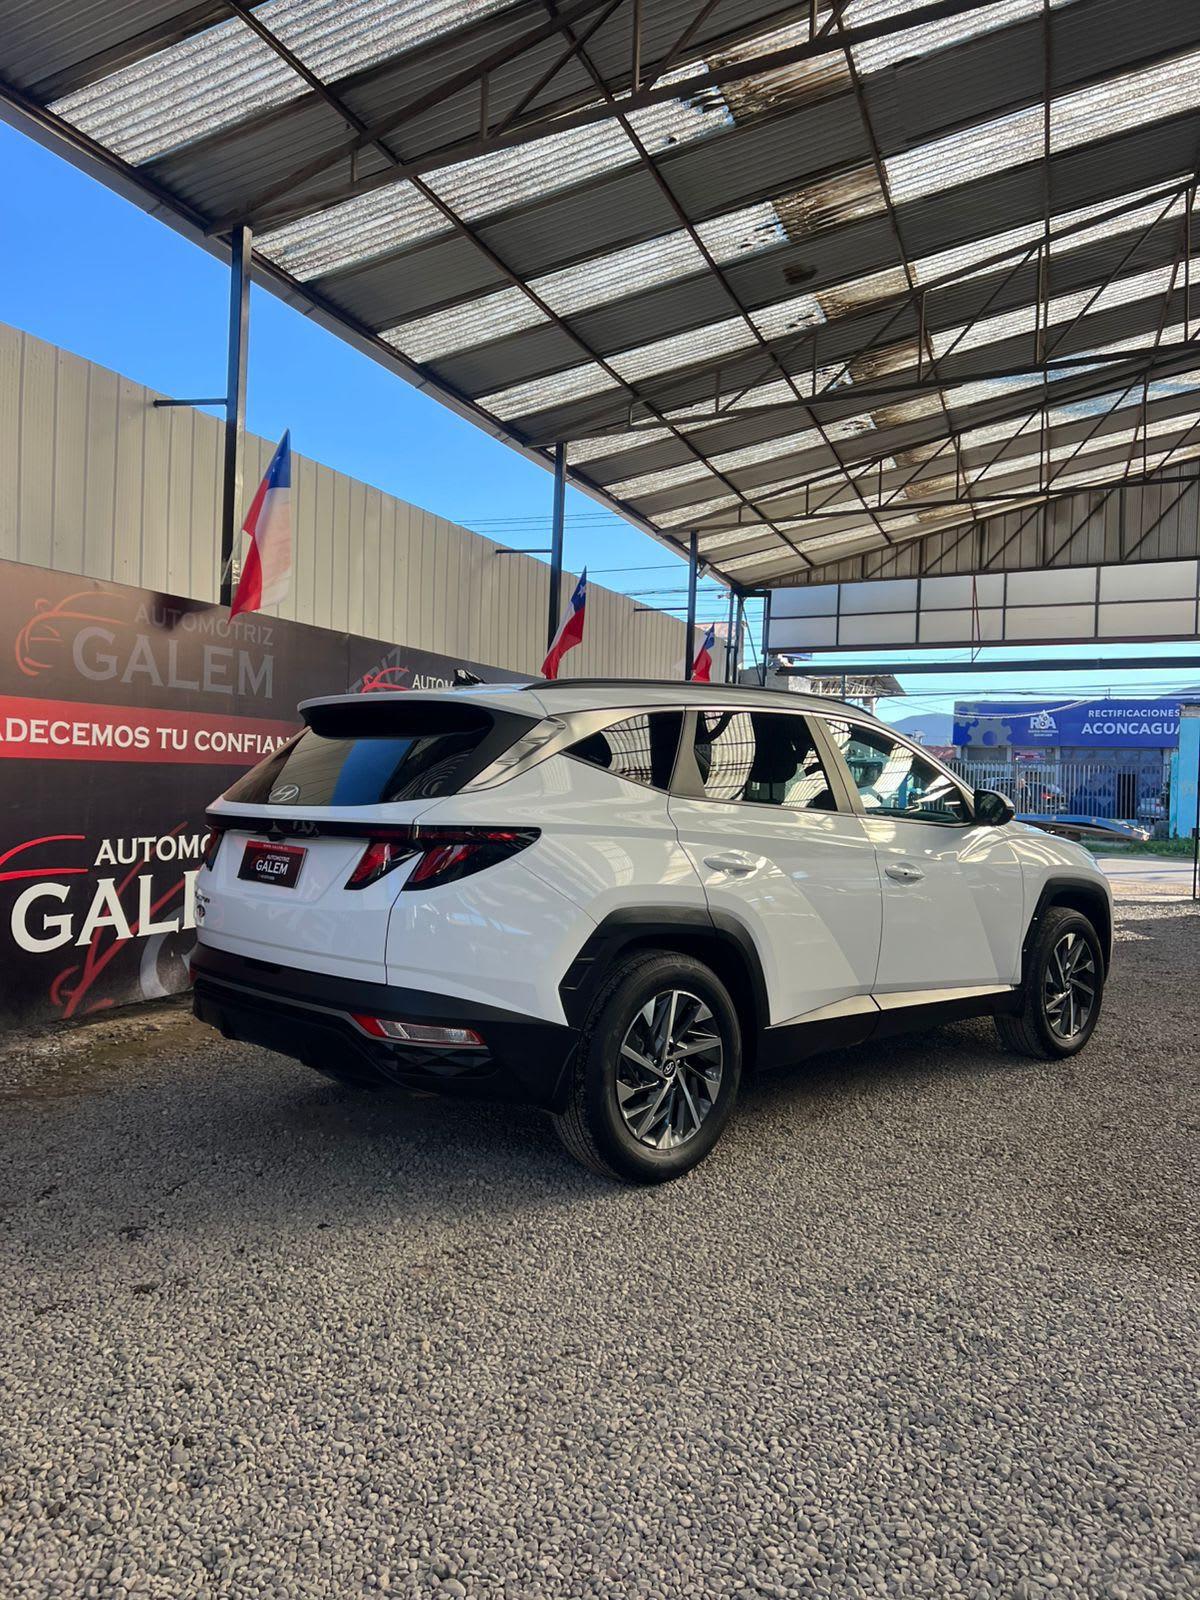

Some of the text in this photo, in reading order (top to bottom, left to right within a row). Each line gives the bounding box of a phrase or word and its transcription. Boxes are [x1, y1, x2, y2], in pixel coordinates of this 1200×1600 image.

[134, 602, 274, 647] AUTOMOTRIZ
[72, 626, 274, 699] GALEM
[1088, 709, 1181, 718] RECTIFICACIONES
[0, 717, 150, 749] DECEMOS
[156, 727, 188, 750] TU
[256, 859, 289, 876] GALEM
